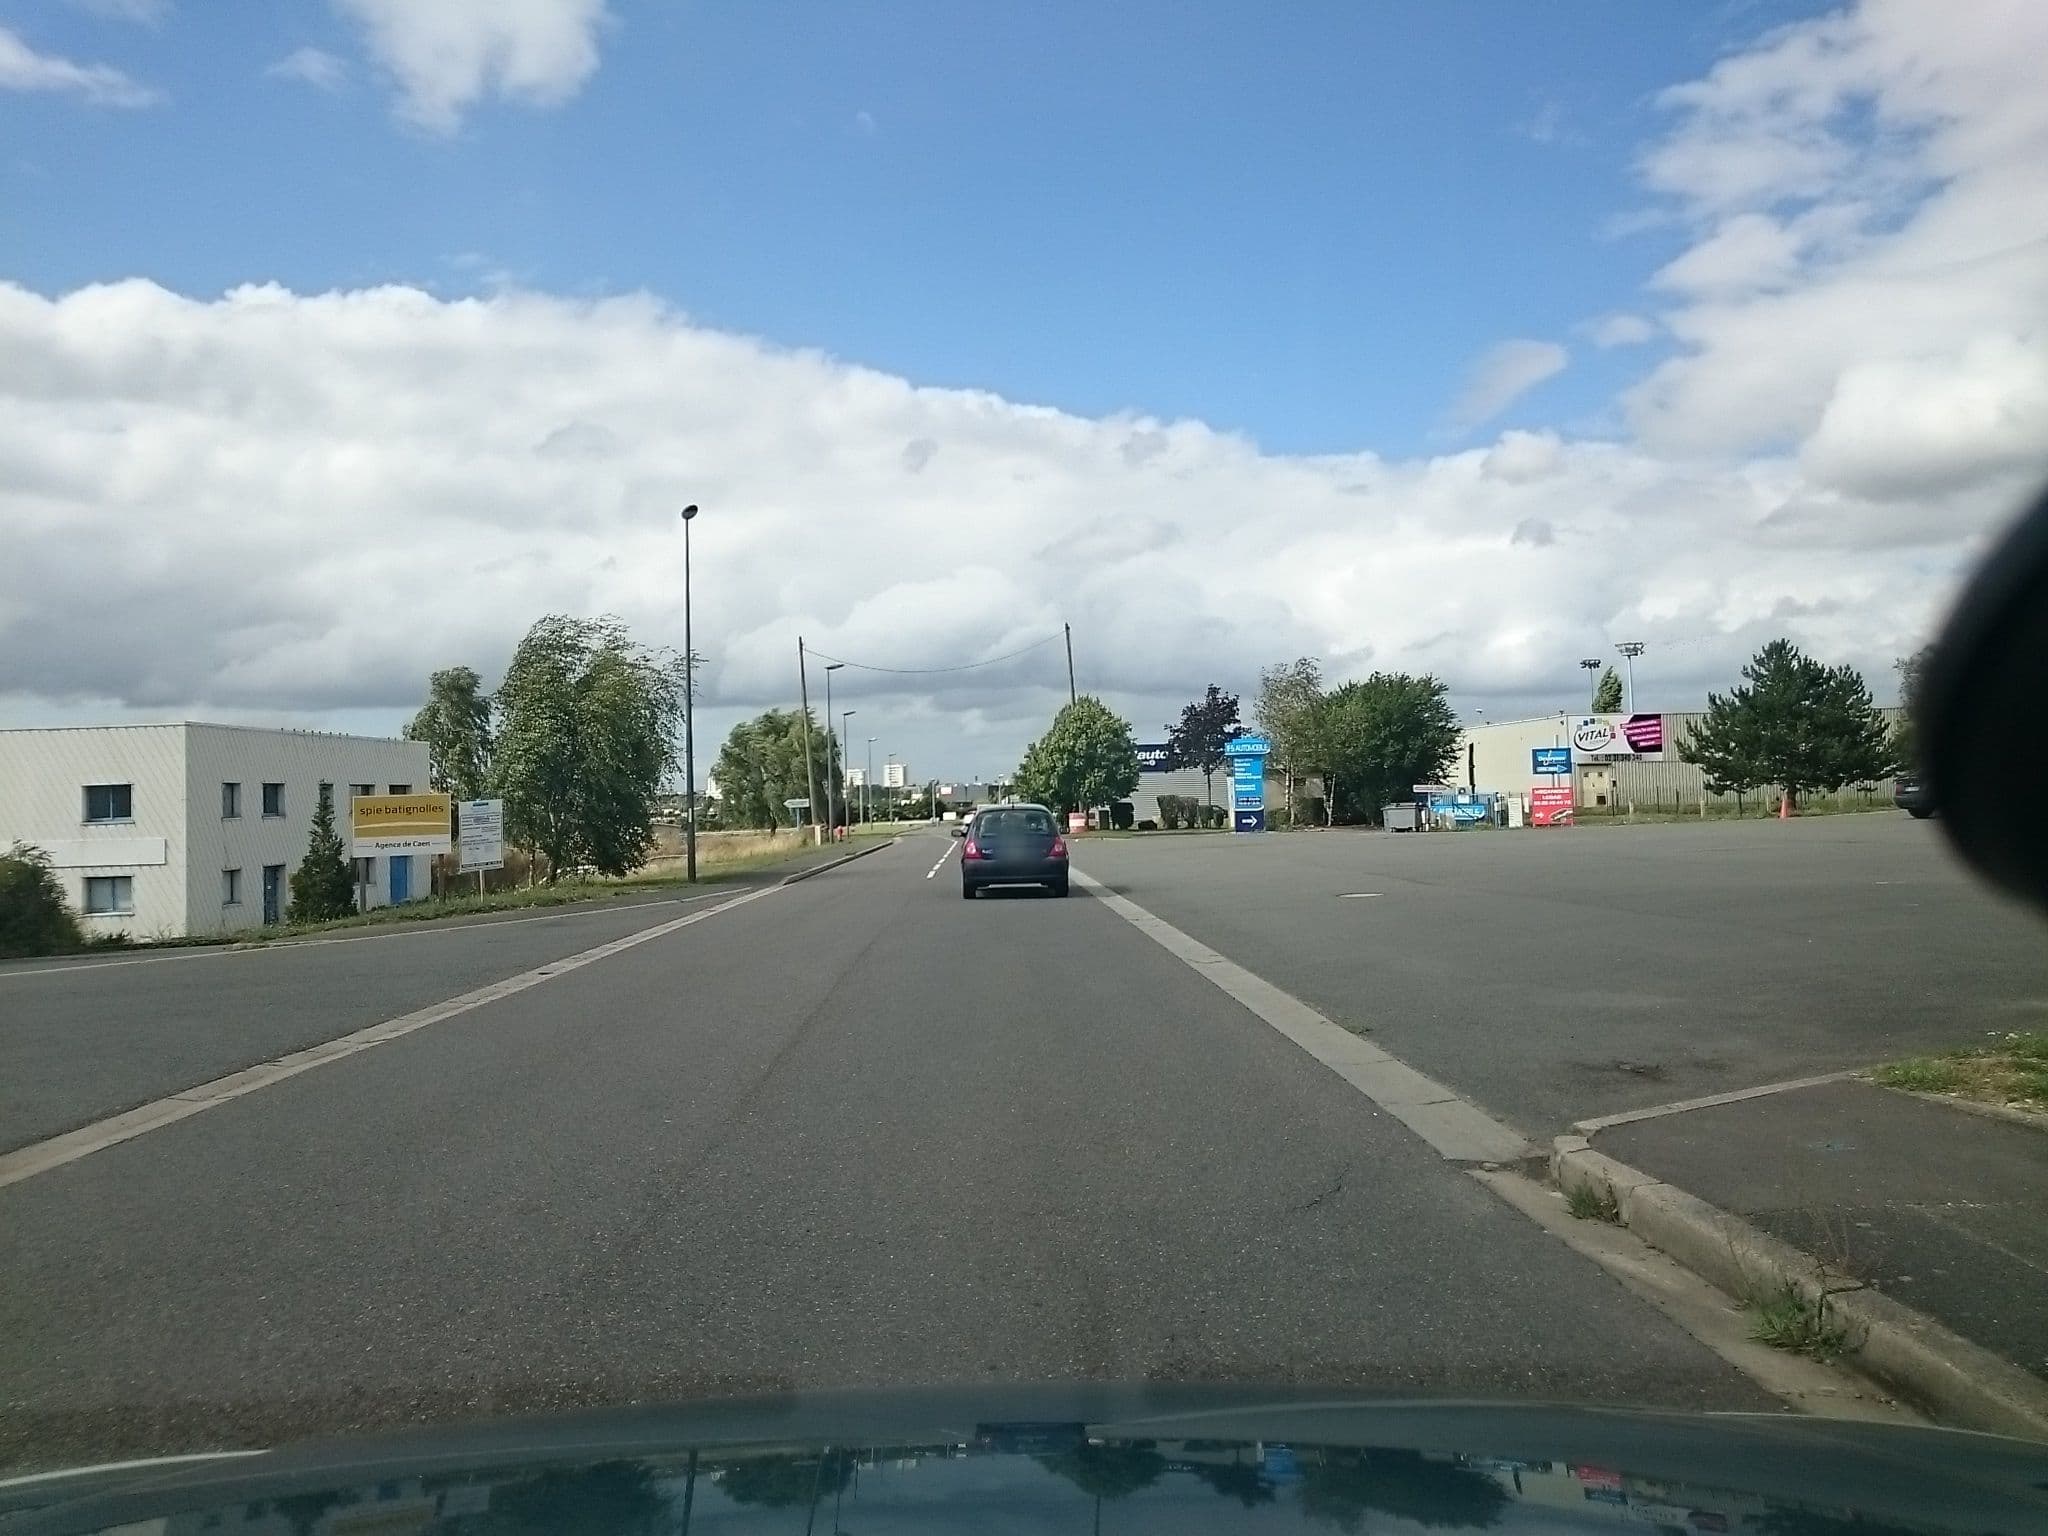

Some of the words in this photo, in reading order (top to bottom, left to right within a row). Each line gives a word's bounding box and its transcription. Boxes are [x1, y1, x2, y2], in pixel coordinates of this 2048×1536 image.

[1578, 728, 1608, 742] VITAL
[359, 806, 383, 817] spie
[384, 804, 444, 815] batignolles
